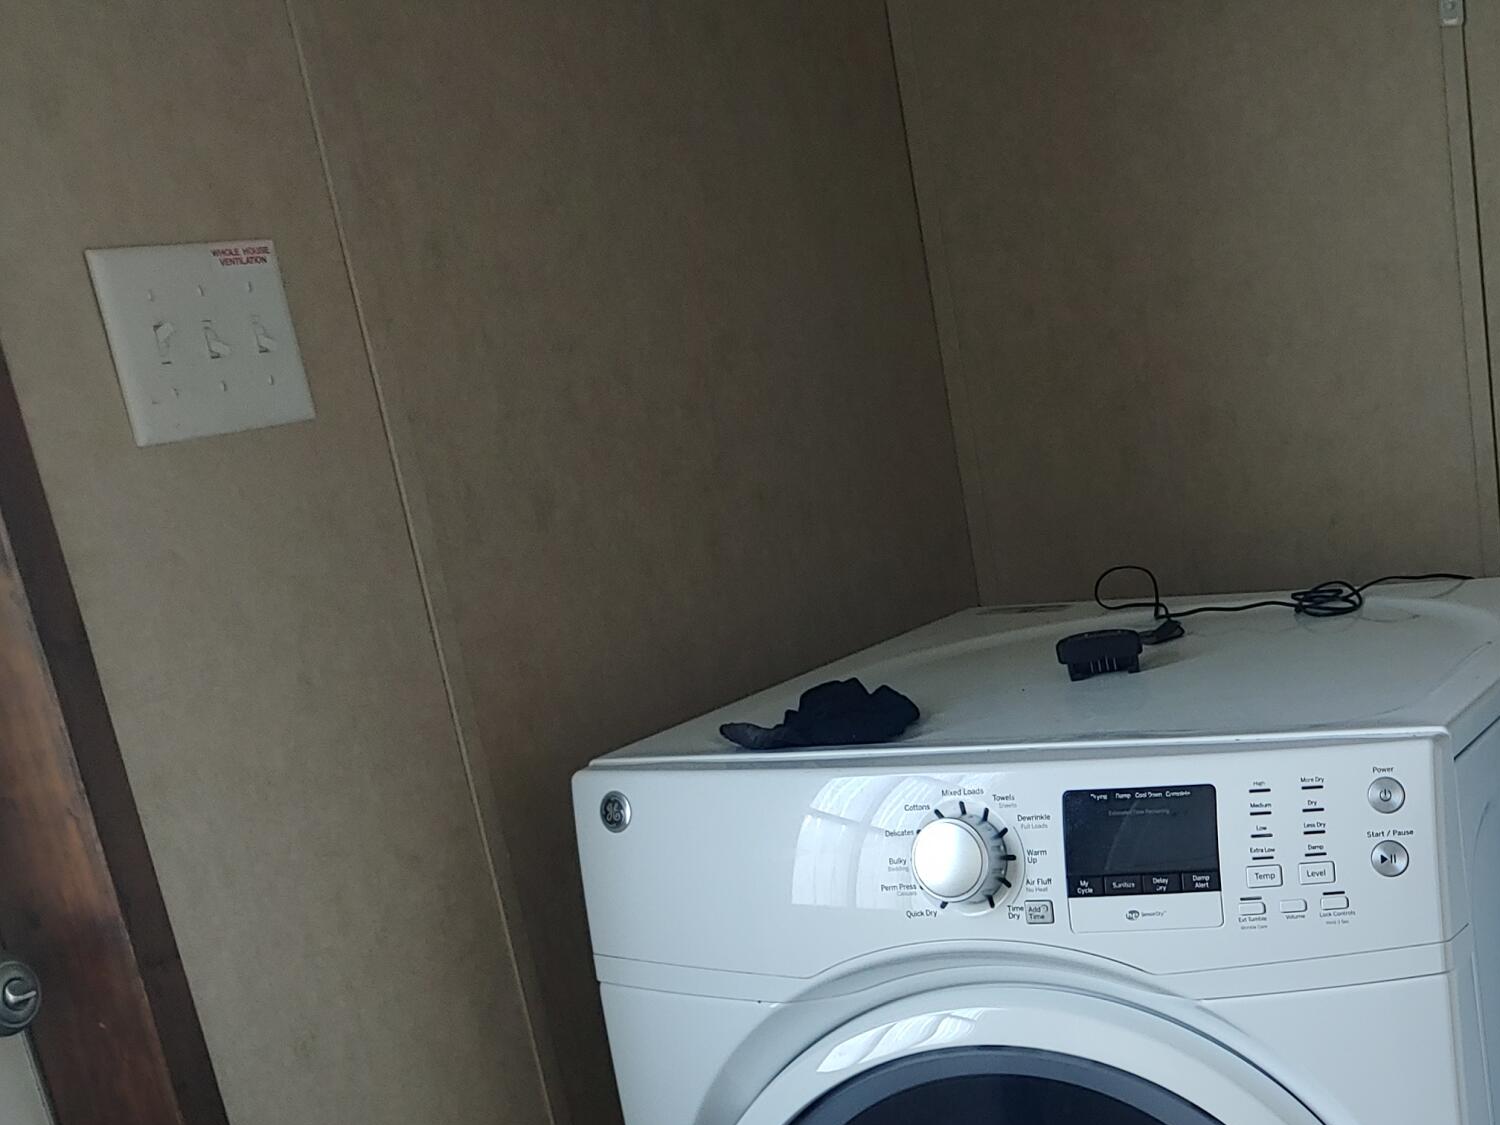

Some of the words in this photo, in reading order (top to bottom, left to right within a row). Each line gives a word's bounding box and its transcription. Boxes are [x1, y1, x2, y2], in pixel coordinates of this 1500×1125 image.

[210, 248, 240, 256] WHOLE
[242, 246, 270, 255] HOUSE
[219, 256, 268, 266] VENTILATION
[1372, 766, 1394, 774] Power
[1314, 776, 1324, 784] Dry
[942, 788, 962, 798] Mixed
[963, 788, 984, 796] Loads
[992, 794, 1016, 802] Towels
[904, 804, 930, 812] Cottons
[1017, 814, 1051, 822] Dewrinkle
[1316, 821, 1326, 829] Dry
[884, 829, 914, 838] Delicates
[1264, 846, 1276, 854] Low
[888, 857, 906, 866] Bulky
[1027, 856, 1038, 864] Up
[1254, 872, 1276, 881] Temp
[1306, 869, 1326, 878] Level
[1026, 878, 1035, 886] Air
[1152, 877, 1168, 886] Delay
[1192, 874, 1210, 883] Damp
[880, 884, 898, 892] Perm
[1080, 880, 1089, 888] My
[1194, 881, 1210, 890] Alert
[1077, 888, 1094, 896] Cycle
[1006, 904, 1024, 912] Time
[906, 910, 924, 920] Quick
[926, 909, 938, 918] Dry
[1008, 912, 1020, 920] Dry
[1334, 910, 1356, 918] Controls
